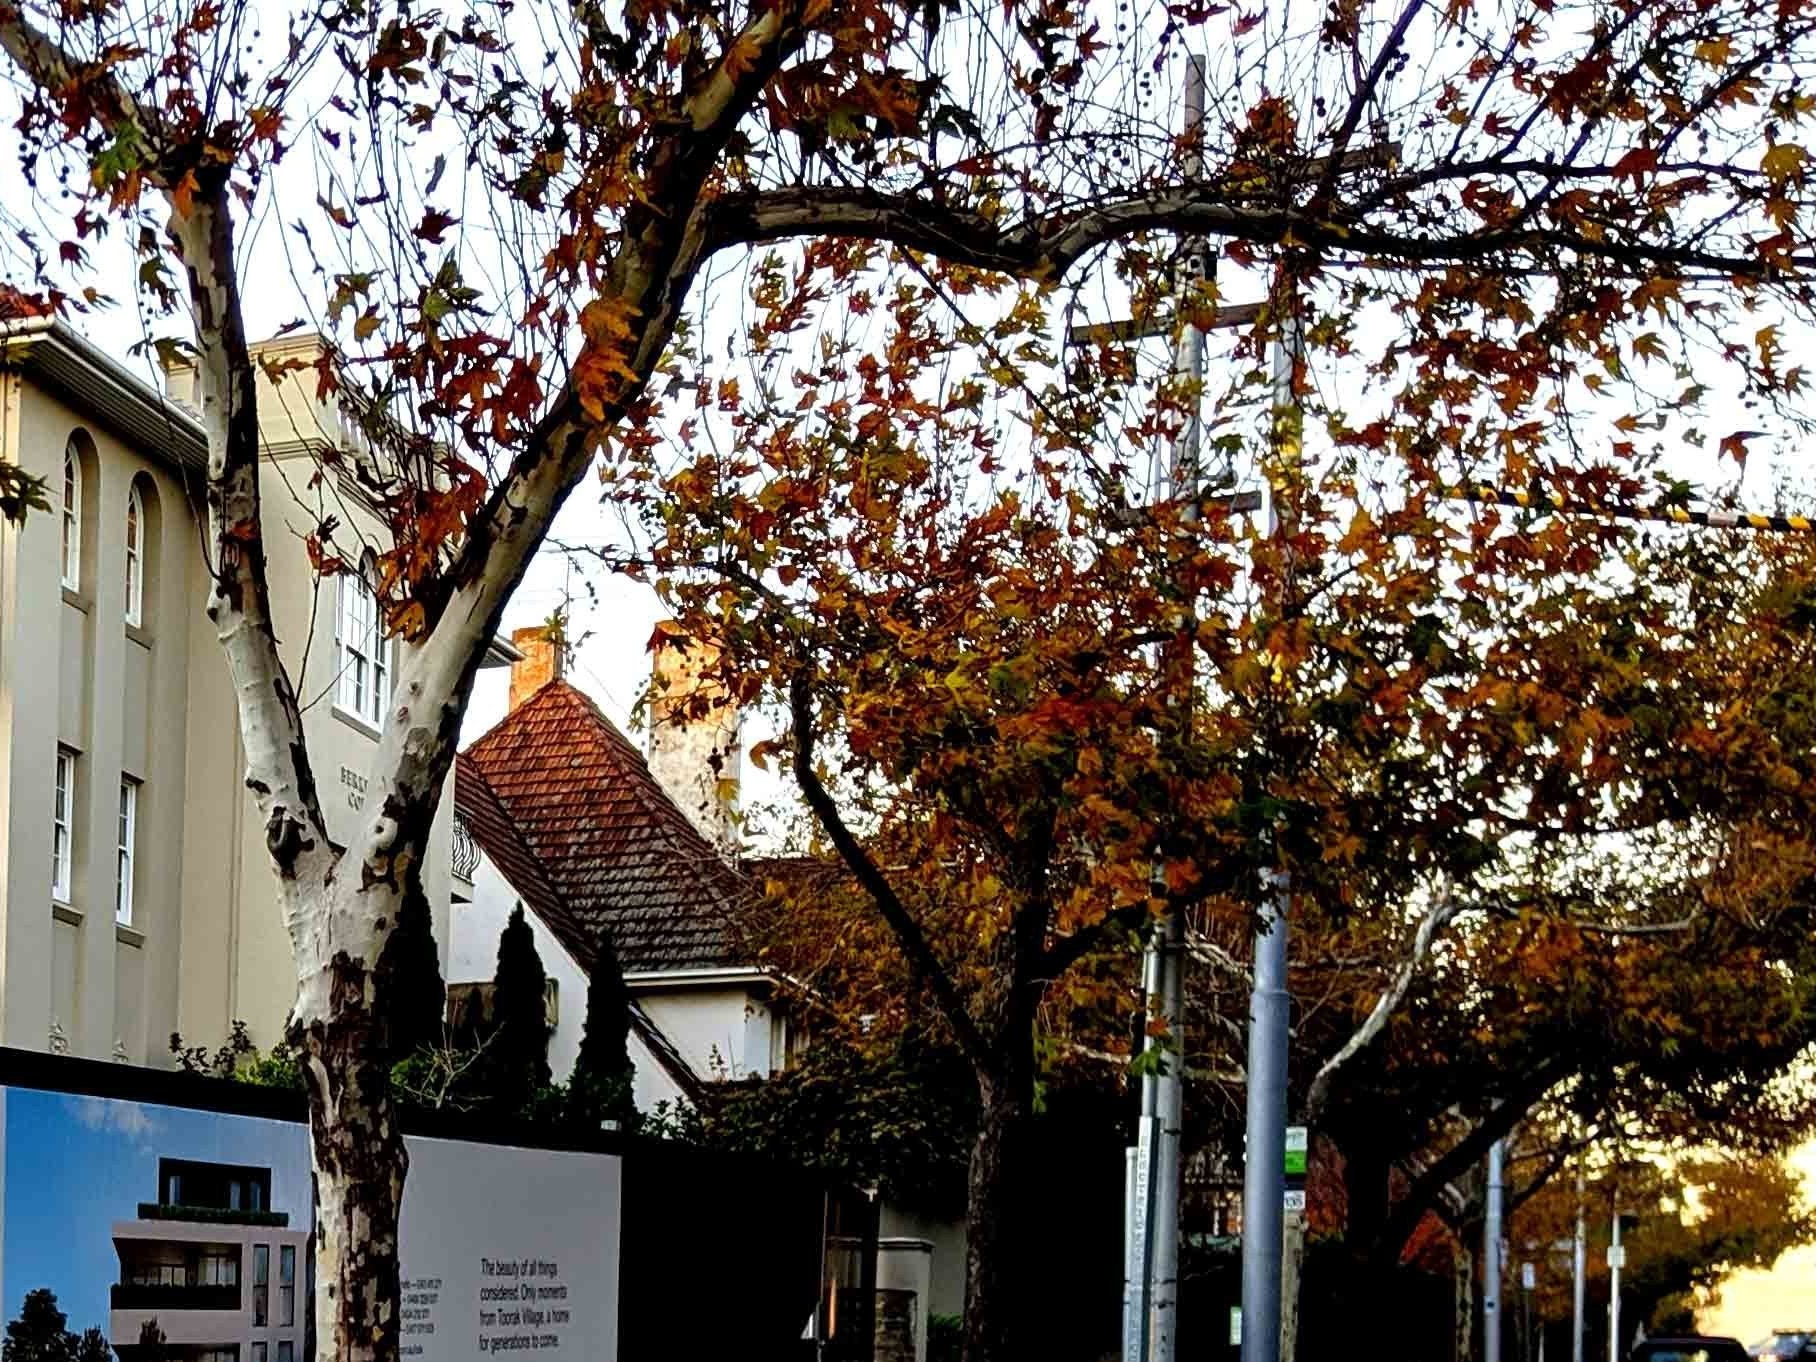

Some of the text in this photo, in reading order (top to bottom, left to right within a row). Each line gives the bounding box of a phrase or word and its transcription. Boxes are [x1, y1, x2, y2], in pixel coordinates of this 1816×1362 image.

[481, 1258, 495, 1276] The
[495, 1258, 519, 1280] beauty
[520, 1258, 529, 1276] of
[529, 1259, 537, 1276] all
[520, 1283, 536, 1304] Only
[480, 1309, 496, 1326] from
[497, 1308, 520, 1325] Toorak
[551, 1309, 569, 1323] home
[479, 1333, 489, 1351] for
[490, 1332, 530, 1355] generations
